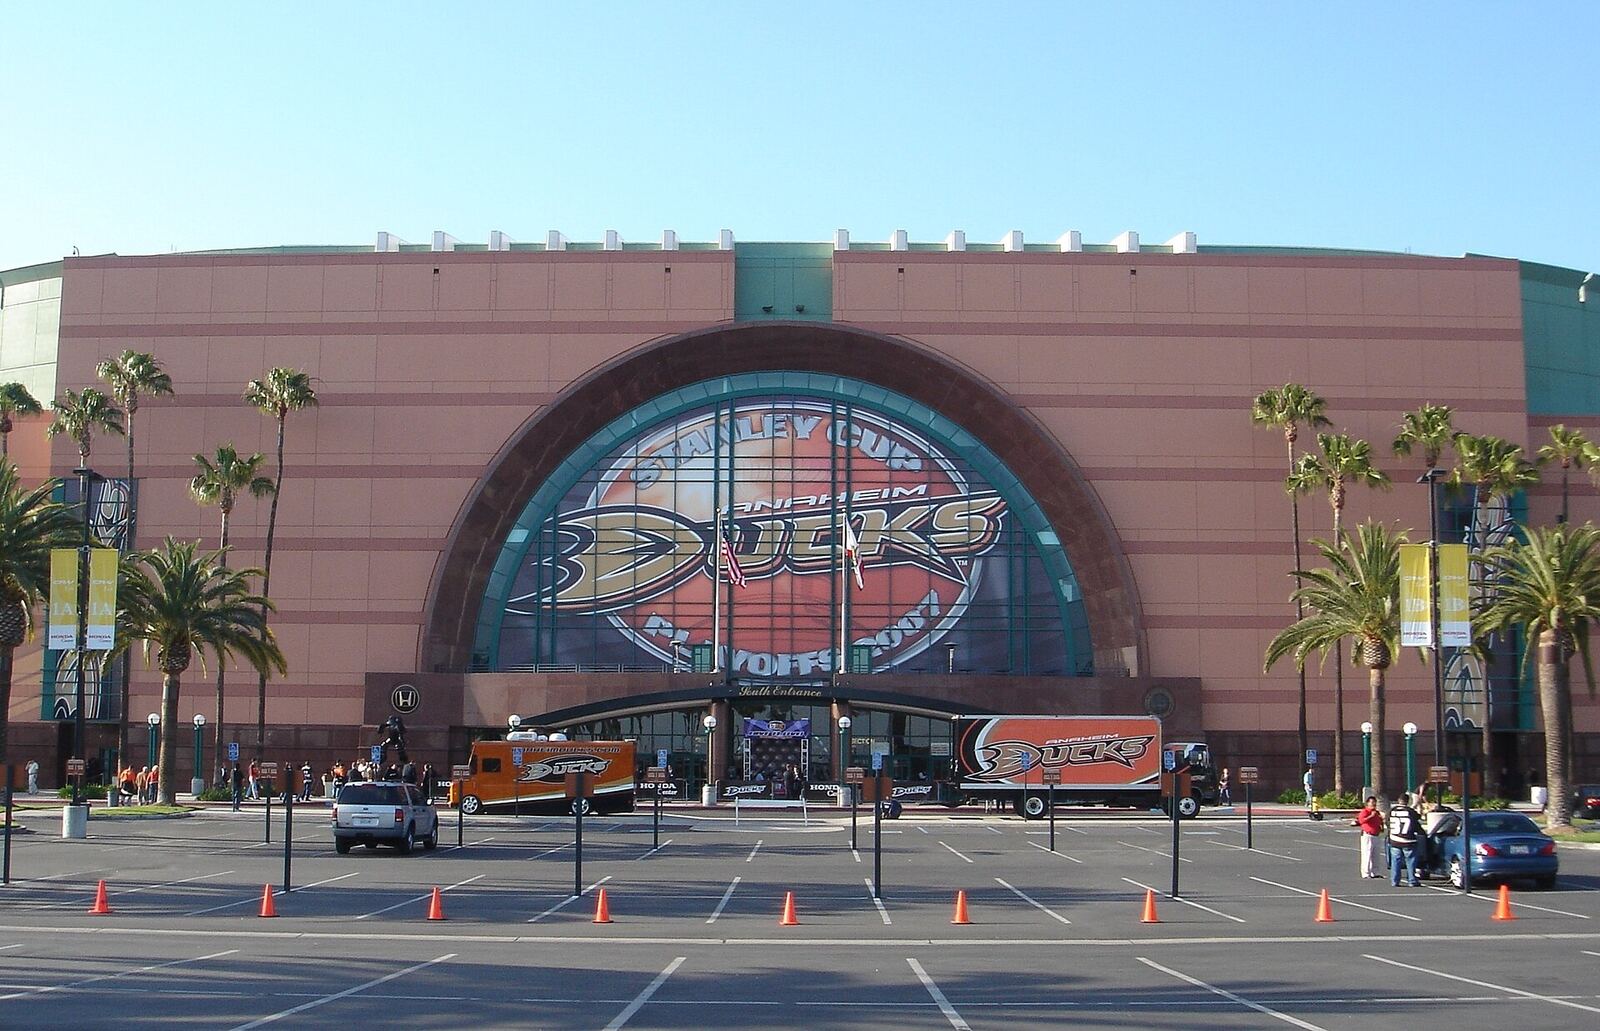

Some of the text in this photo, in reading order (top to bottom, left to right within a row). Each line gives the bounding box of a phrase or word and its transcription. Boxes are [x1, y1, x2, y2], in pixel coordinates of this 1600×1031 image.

[630, 413, 923, 490] STANLEY CUP
[723, 484, 928, 514] ANAHEIM
[641, 612, 842, 677] PLYOFFS
[739, 685, 822, 697] South Entrance
[1045, 733, 1120, 746] ANAHEIM
